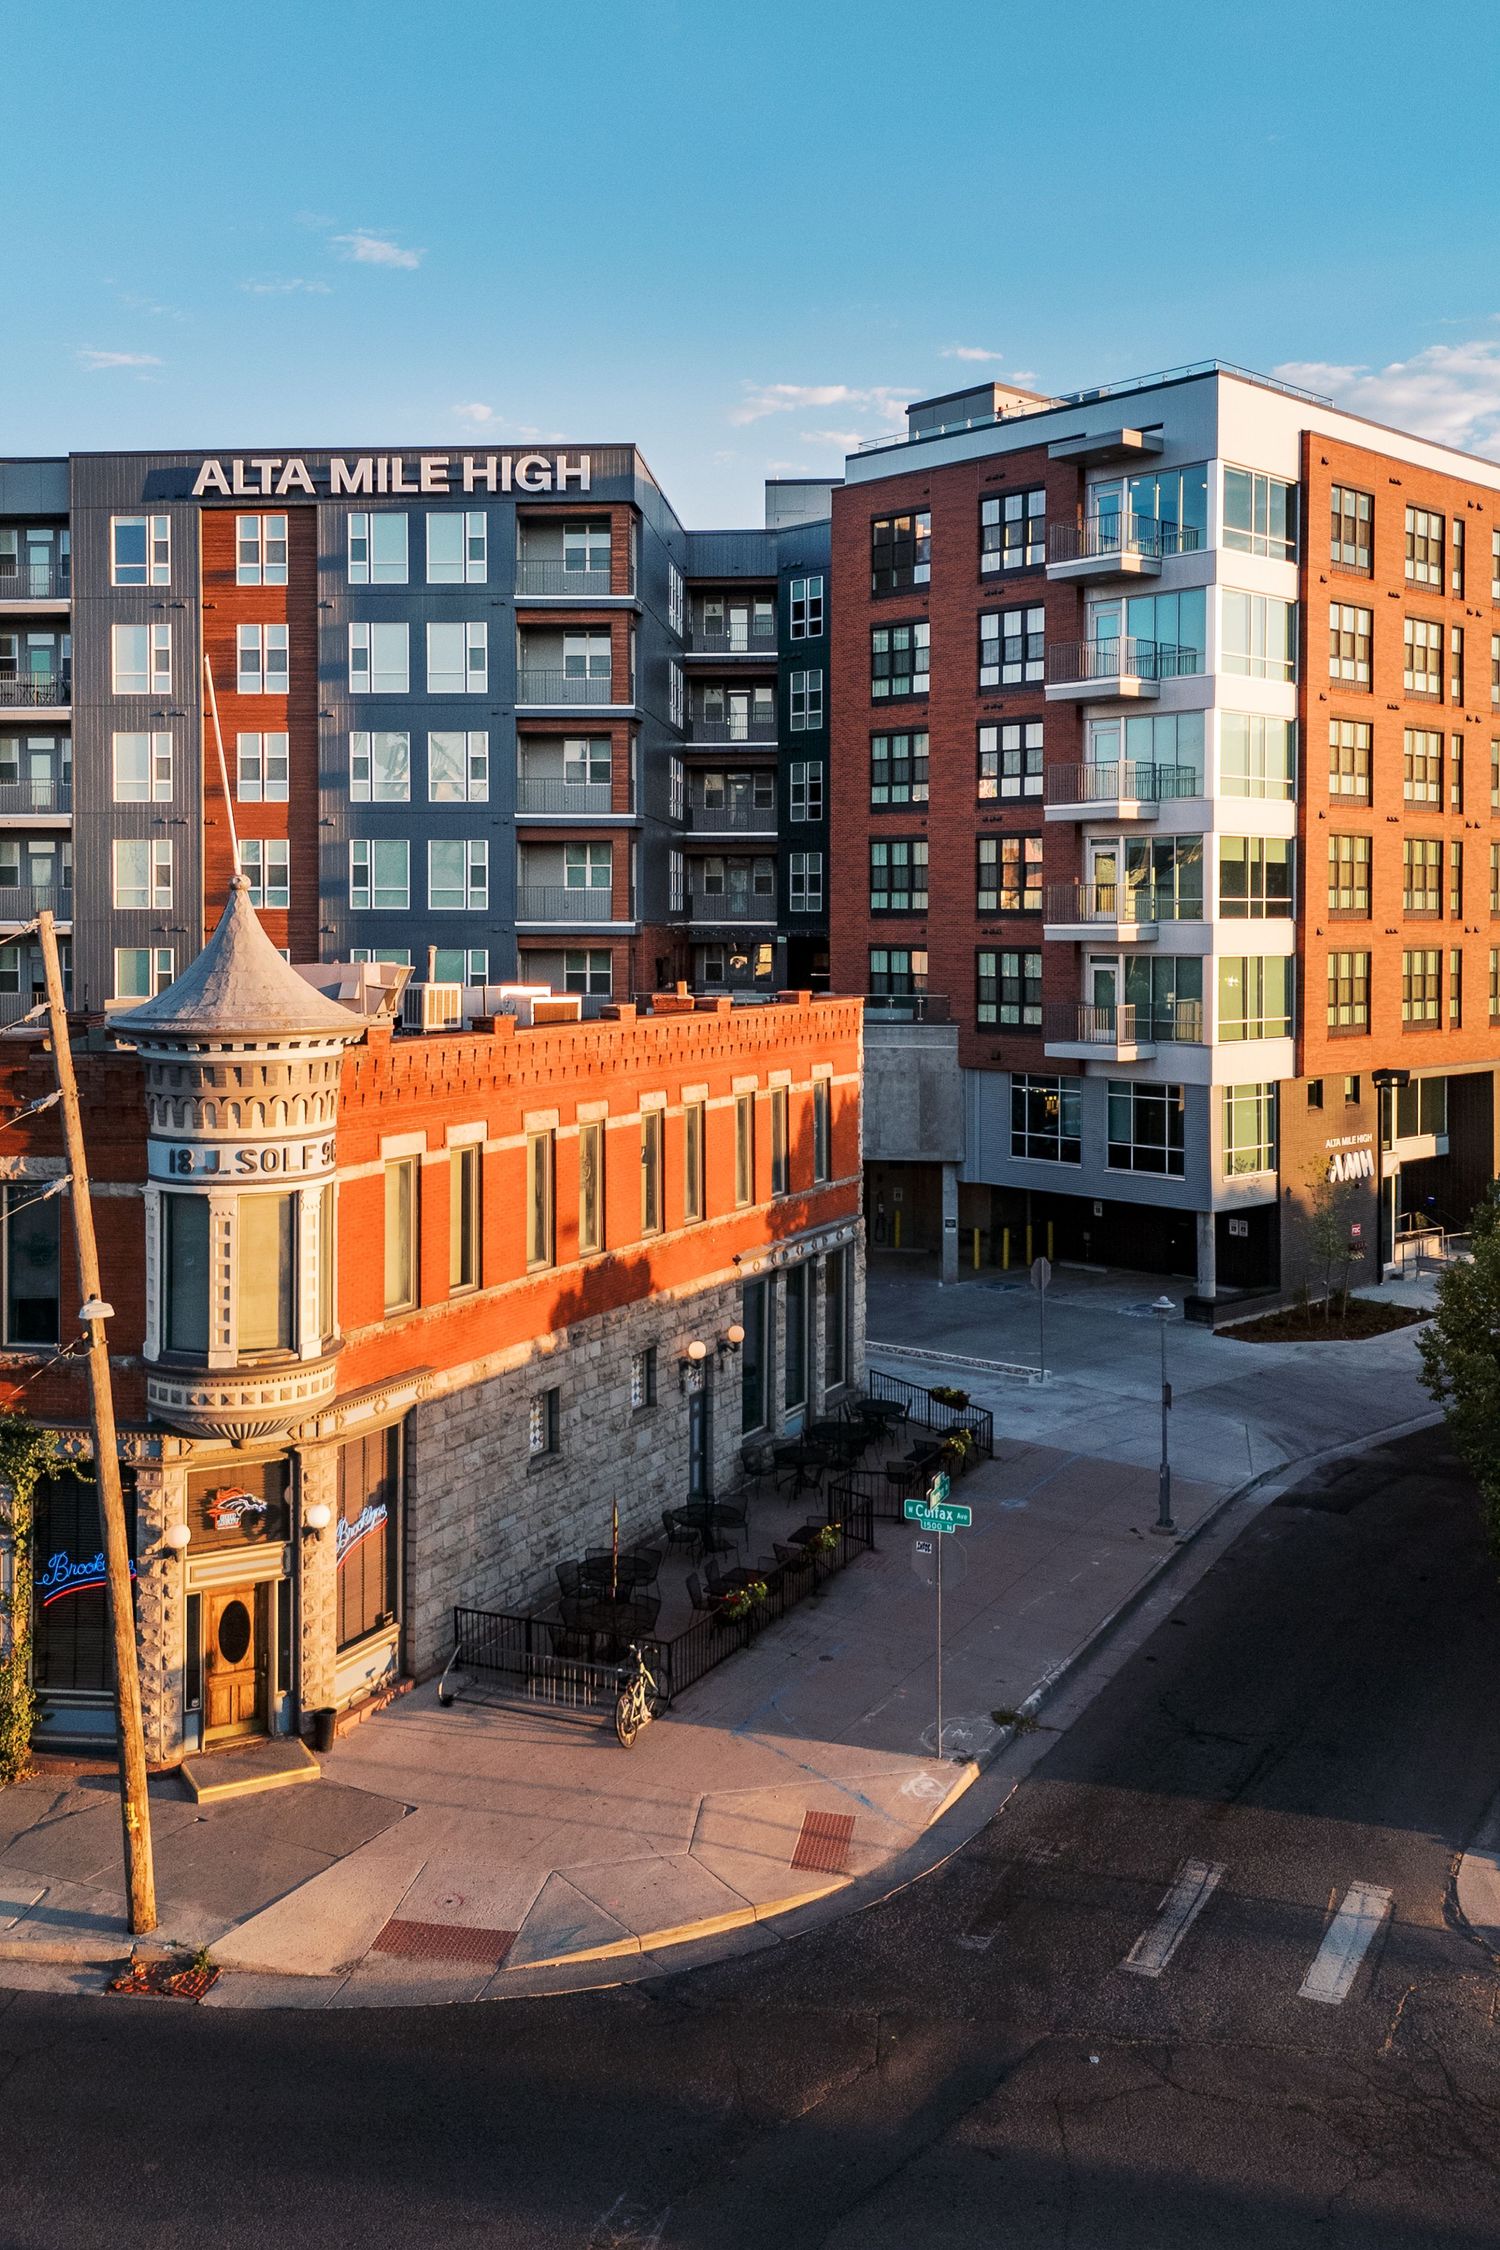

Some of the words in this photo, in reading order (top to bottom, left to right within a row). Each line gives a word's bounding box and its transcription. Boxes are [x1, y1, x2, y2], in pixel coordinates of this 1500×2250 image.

[191, 457, 316, 496] ALTA
[330, 456, 450, 494] MILE
[462, 454, 591, 493] HIGH
[1325, 1137, 1341, 1149] ALTA
[1341, 1135, 1357, 1146] MILE
[1357, 1133, 1373, 1144] HIGH
[169, 1148, 195, 1175] 18
[235, 1143, 317, 1175] SOLF
[956, 1513, 968, 1521] Ave
[923, 1520, 942, 1531] 1500
[946, 1524, 953, 1532] N
